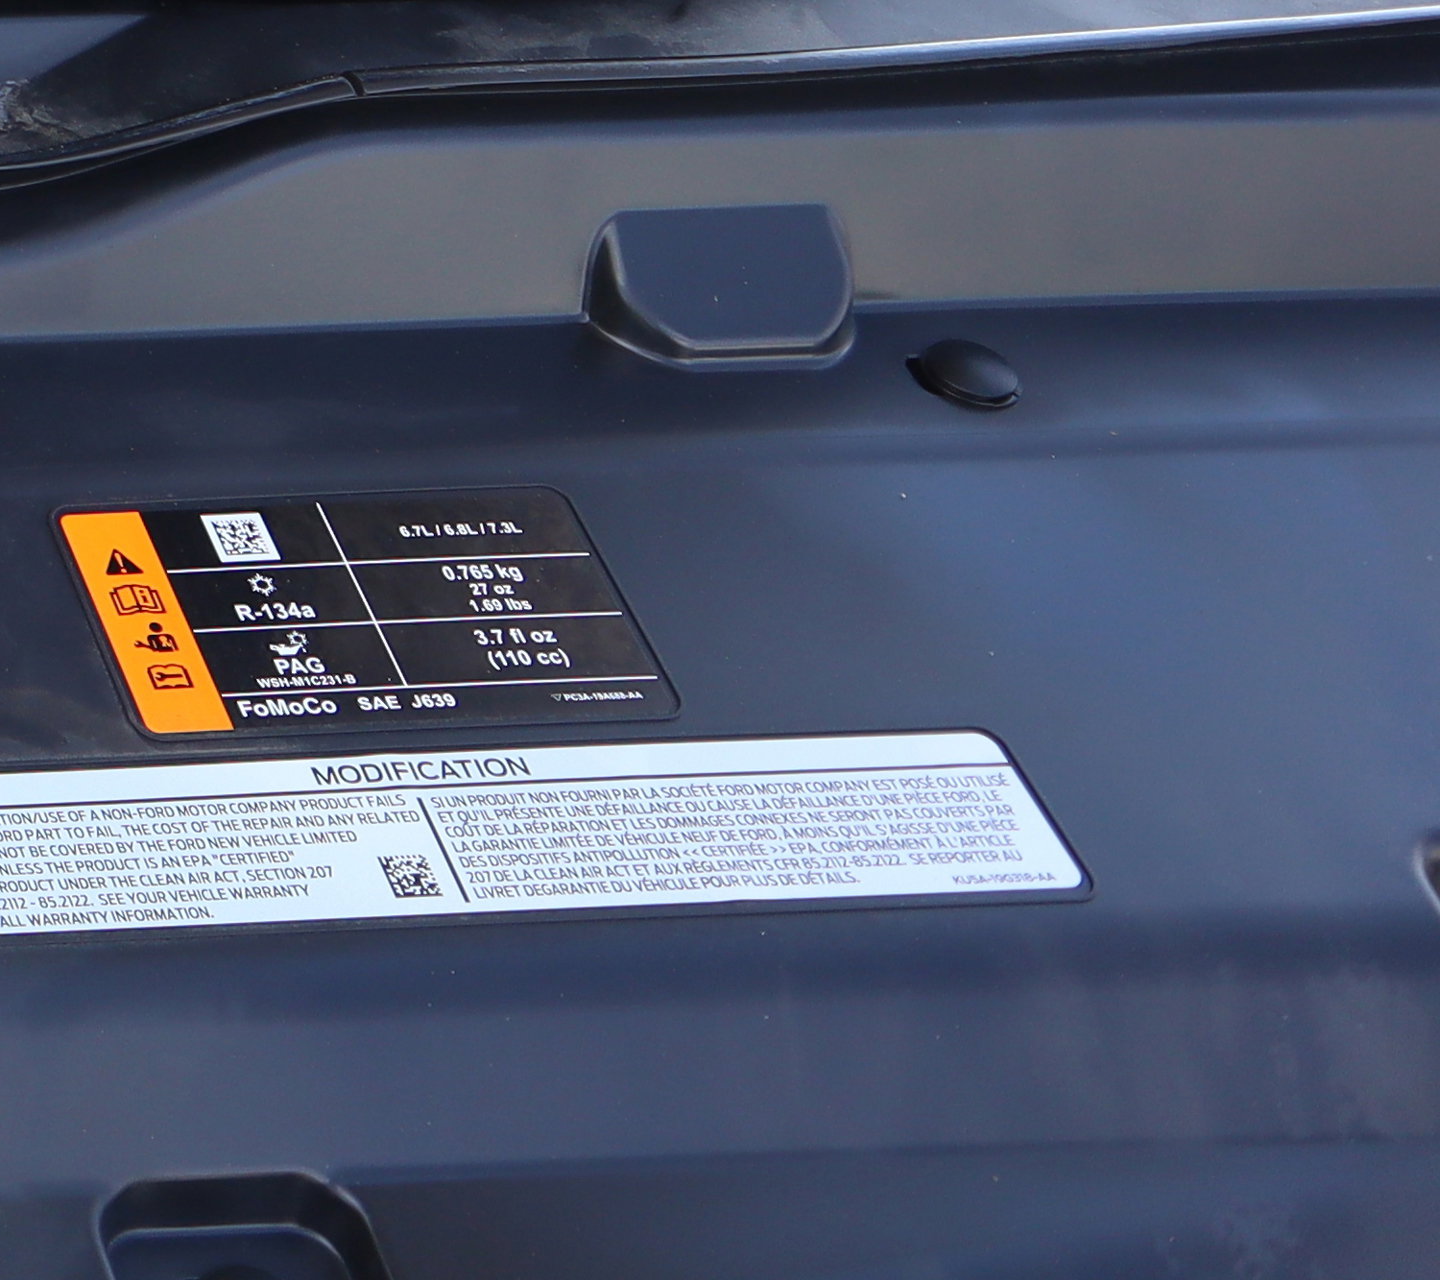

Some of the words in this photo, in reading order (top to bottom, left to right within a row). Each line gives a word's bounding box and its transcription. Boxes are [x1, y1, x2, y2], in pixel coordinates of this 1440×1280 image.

[399, 524, 433, 538] 6.7L
[444, 523, 478, 537] 6.8L
[487, 521, 523, 535] 7.3L
[441, 565, 493, 582] 0.765
[494, 563, 524, 583] kg
[469, 583, 489, 596] 27
[494, 583, 515, 595] oz
[234, 602, 316, 622] R-134a
[469, 598, 504, 614] 1.69
[505, 597, 533, 612] lbs
[473, 628, 506, 646] 3.7
[508, 627, 528, 645] fl
[530, 629, 558, 644] oz
[273, 656, 326, 675] PAG
[487, 649, 533, 671] (110
[537, 648, 571, 668] cc)
[256, 674, 358, 689] WSH-M1C231-B
[237, 696, 338, 718] FoMoCo
[357, 694, 401, 711] SAE
[411, 692, 457, 709] J639
[311, 756, 532, 786] MODIFICATION
[430, 796, 446, 809] SI
[444, 795, 468, 808] UN
[640, 787, 662, 800] LA
[935, 776, 959, 788] OU
[67, 809, 87, 823] OF
[90, 809, 101, 821] A
[100, 806, 175, 821] NON-FORD
[175, 803, 228, 817] MOTOR
[228, 799, 296, 815] COMPANY
[298, 796, 364, 811] PRODUCT
[365, 794, 407, 807] FAILS
[24, 827, 62, 841] PART
[63, 826, 85, 839] TO
[85, 825, 122, 838] FAIL,
[120, 823, 152, 837] THE
[151, 821, 188, 835] COST
[190, 820, 209, 833] OF
[210, 819, 242, 832] THE
[241, 816, 294, 831] REPAIR
[295, 815, 325, 828] AND
[327, 813, 354, 826] ANY
[356, 810, 421, 825] RELATED
[28, 845, 49, 858] BE
[49, 842, 115, 857] COVERED
[115, 841, 134, 854] BY
[135, 839, 167, 853] THE
[166, 837, 206, 851] FORD
[206, 836, 240, 849] NEW
[241, 833, 301, 848] VEHICLE
[300, 830, 358, 845] LIMITED
[43, 860, 75, 874] THE
[74, 857, 141, 873] PRODUCT
[143, 856, 159, 869] IS
[161, 856, 182, 868] AN
[181, 854, 212, 868] EPA
[211, 850, 295, 866] "CERTIFIED"
[57, 876, 108, 891] UNDER
[107, 875, 139, 888] THE
[138, 873, 186, 887] CLEAN
[188, 871, 212, 885] AIR
[214, 870, 246, 884] ACT,
[245, 867, 307, 882] SECTION
[306, 865, 332, 879] 207
[609, 880, 633, 893] DU
[777, 873, 799, 886] DE
[37, 894, 94, 909] 85.2122.
[97, 892, 127, 906] SEE
[125, 890, 168, 904] YOUR
[167, 887, 229, 903] VEHICLE
[227, 884, 309, 900] WARRANTY
[0, 914, 27, 928] ALL
[25, 910, 108, 927] WARRANTY
[110, 906, 215, 922] INFORMATION.
